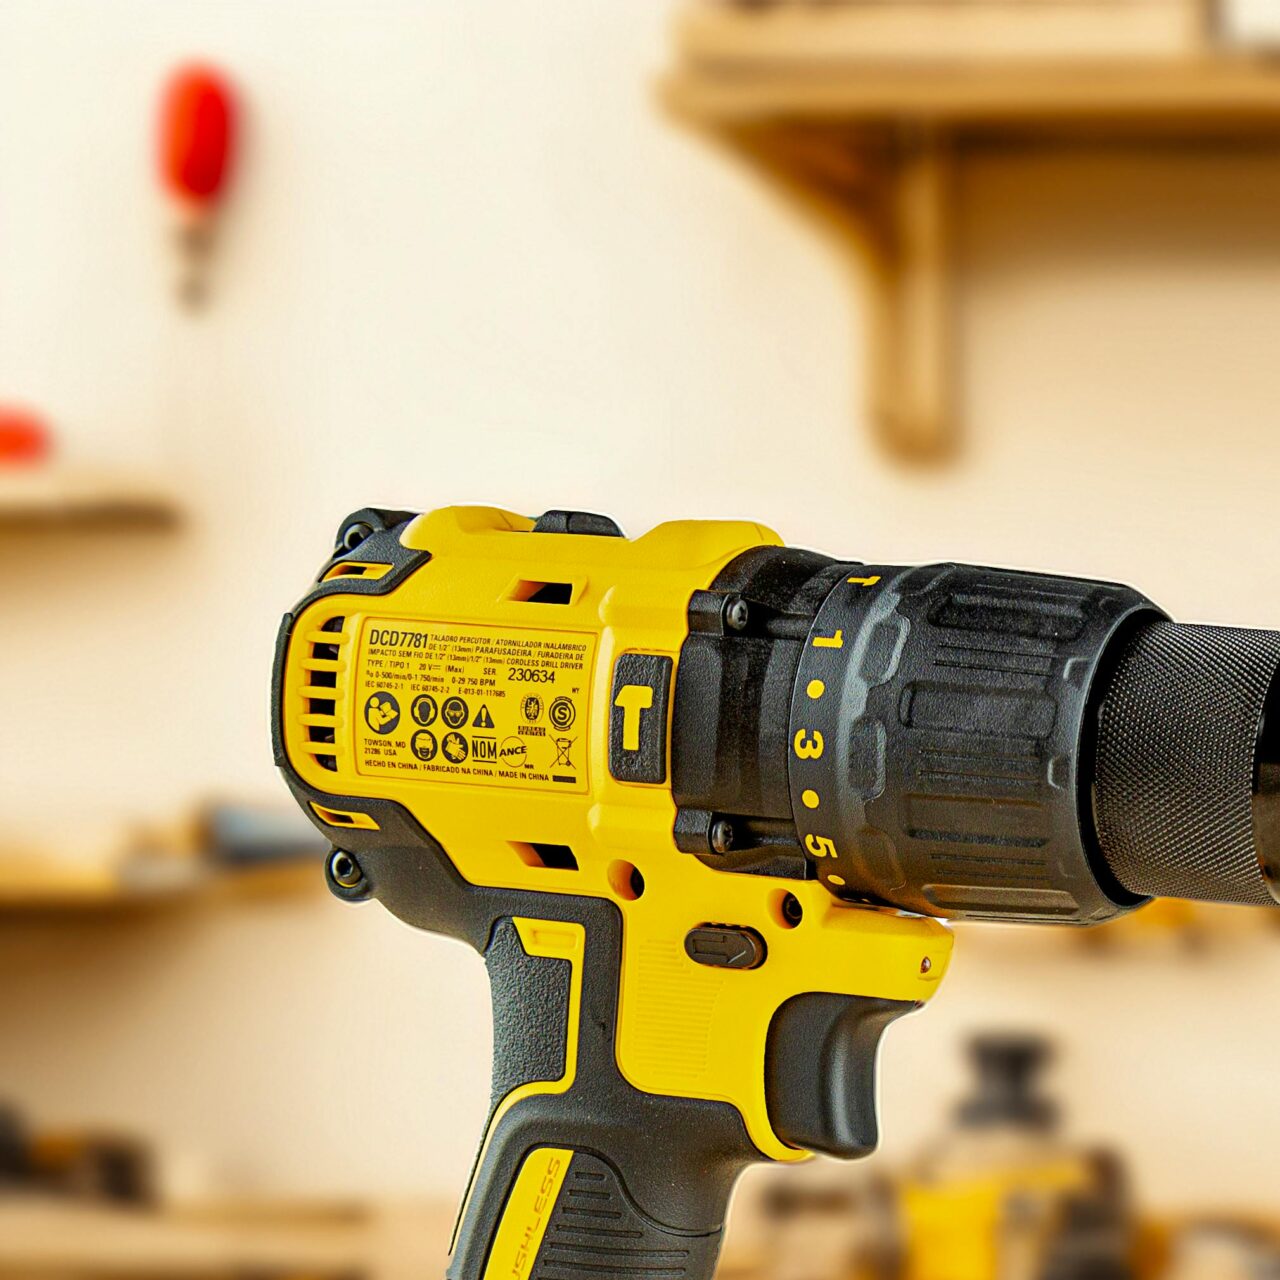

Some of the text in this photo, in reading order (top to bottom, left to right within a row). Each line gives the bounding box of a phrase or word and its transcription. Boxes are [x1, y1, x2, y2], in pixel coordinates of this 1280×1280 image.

[370, 630, 428, 648] DCD7781
[460, 636, 490, 644] PERCUTOR
[496, 639, 542, 648] ATORNILLADOR
[812, 630, 844, 648] 1
[368, 648, 396, 656] IMPACTO
[506, 658, 539, 667] CORDLESS
[541, 660, 558, 668] DRILL
[560, 662, 583, 670] DRIVER
[475, 646, 532, 657] PARAFUSADEIRA
[537, 651, 574, 660] FURADEIRA
[368, 659, 383, 667] TYPE
[390, 660, 404, 669] TIPO
[508, 668, 555, 683] 230634
[472, 740, 497, 759] NOM
[499, 746, 527, 757] ANCE
[794, 728, 824, 760] 3
[424, 764, 459, 773] FABRICADO
[472, 768, 493, 776] CHINA
[498, 770, 517, 778] MADE
[528, 773, 549, 781] CHINA
[805, 834, 838, 858] 5
